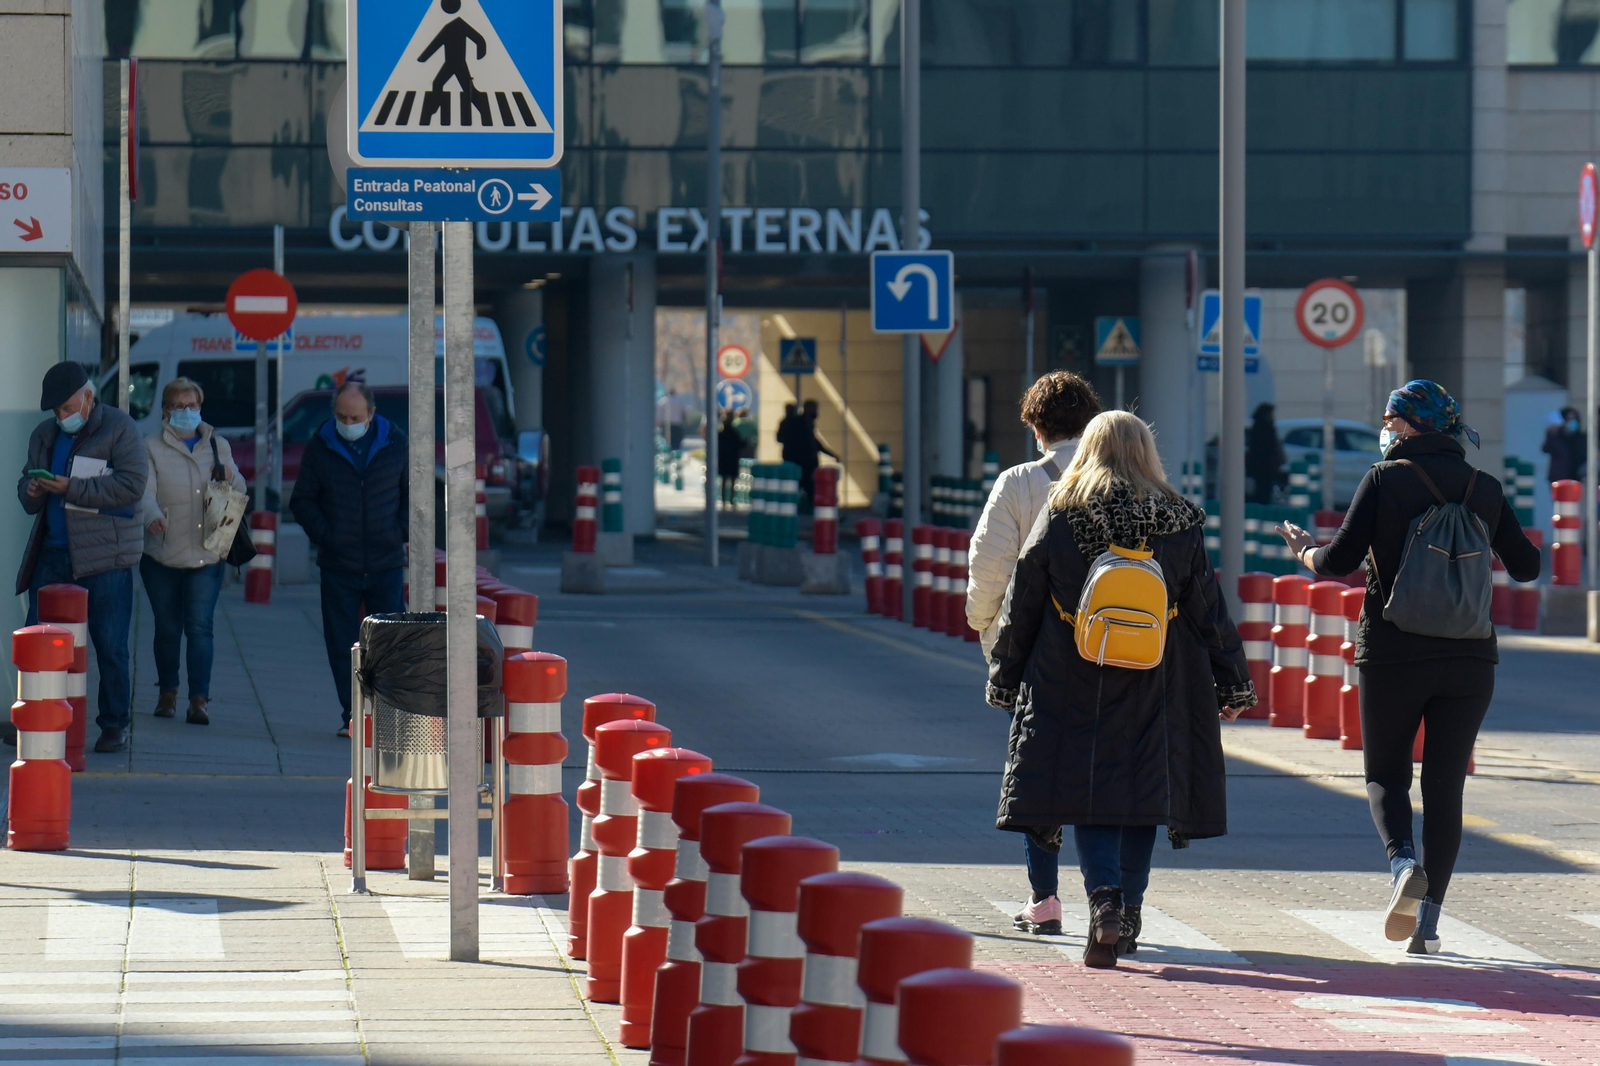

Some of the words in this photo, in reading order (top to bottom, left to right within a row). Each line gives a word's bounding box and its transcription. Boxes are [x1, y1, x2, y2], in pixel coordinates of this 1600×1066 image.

[353, 178, 409, 193] Entrada
[413, 178, 476, 193] Peatonal
[353, 198, 423, 212] Consultas
[329, 204, 638, 251] COULTAS
[1311, 301, 1350, 324] 20
[191, 336, 232, 351] TRANS
